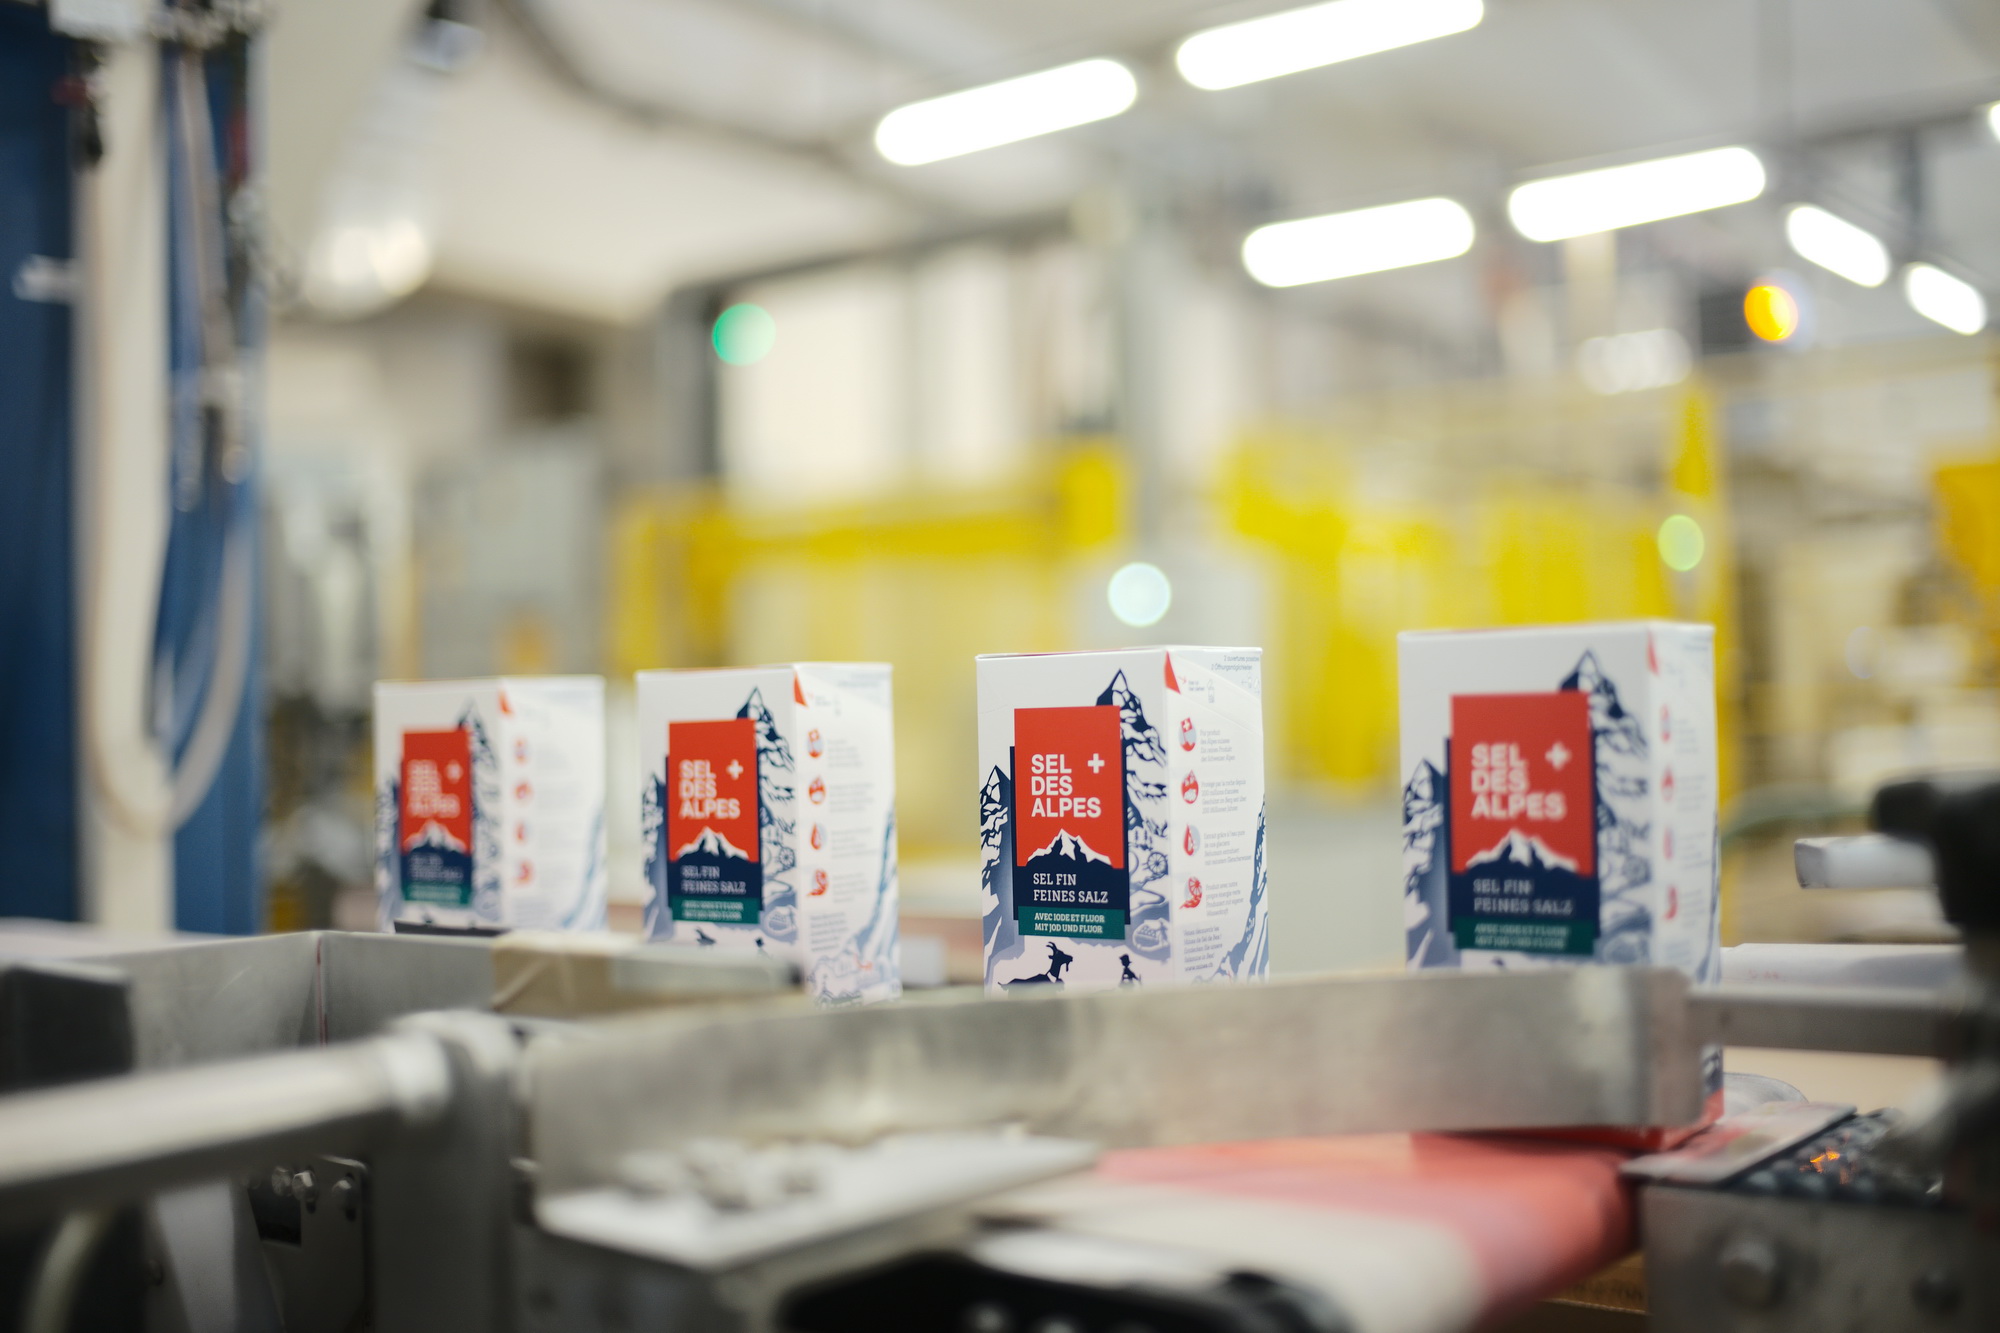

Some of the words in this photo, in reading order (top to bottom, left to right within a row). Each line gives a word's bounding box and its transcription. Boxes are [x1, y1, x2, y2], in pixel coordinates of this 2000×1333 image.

[1031, 753, 1073, 775] SEL
[1471, 742, 1528, 768] SEL
[680, 759, 717, 780] SEL
[680, 779, 718, 800] DES
[1031, 775, 1074, 796] DES
[1471, 768, 1530, 794] DES
[680, 798, 741, 820] ALPES
[1031, 796, 1102, 819] ALPES
[1471, 792, 1567, 819] ALPES
[1033, 872, 1054, 885] SEL
[1056, 873, 1077, 886] FIN
[1033, 889, 1076, 903] FEINES
[1078, 890, 1109, 904] SALZ
[1034, 912, 1053, 921] AVEC
[1053, 913, 1071, 922] IODE
[1071, 914, 1080, 922] ET
[1081, 914, 1105, 923] FLUOR
[1035, 923, 1049, 931] MIT
[1049, 923, 1062, 933] JOD
[1062, 924, 1079, 933] UND
[1079, 925, 1103, 934] FLUOR
